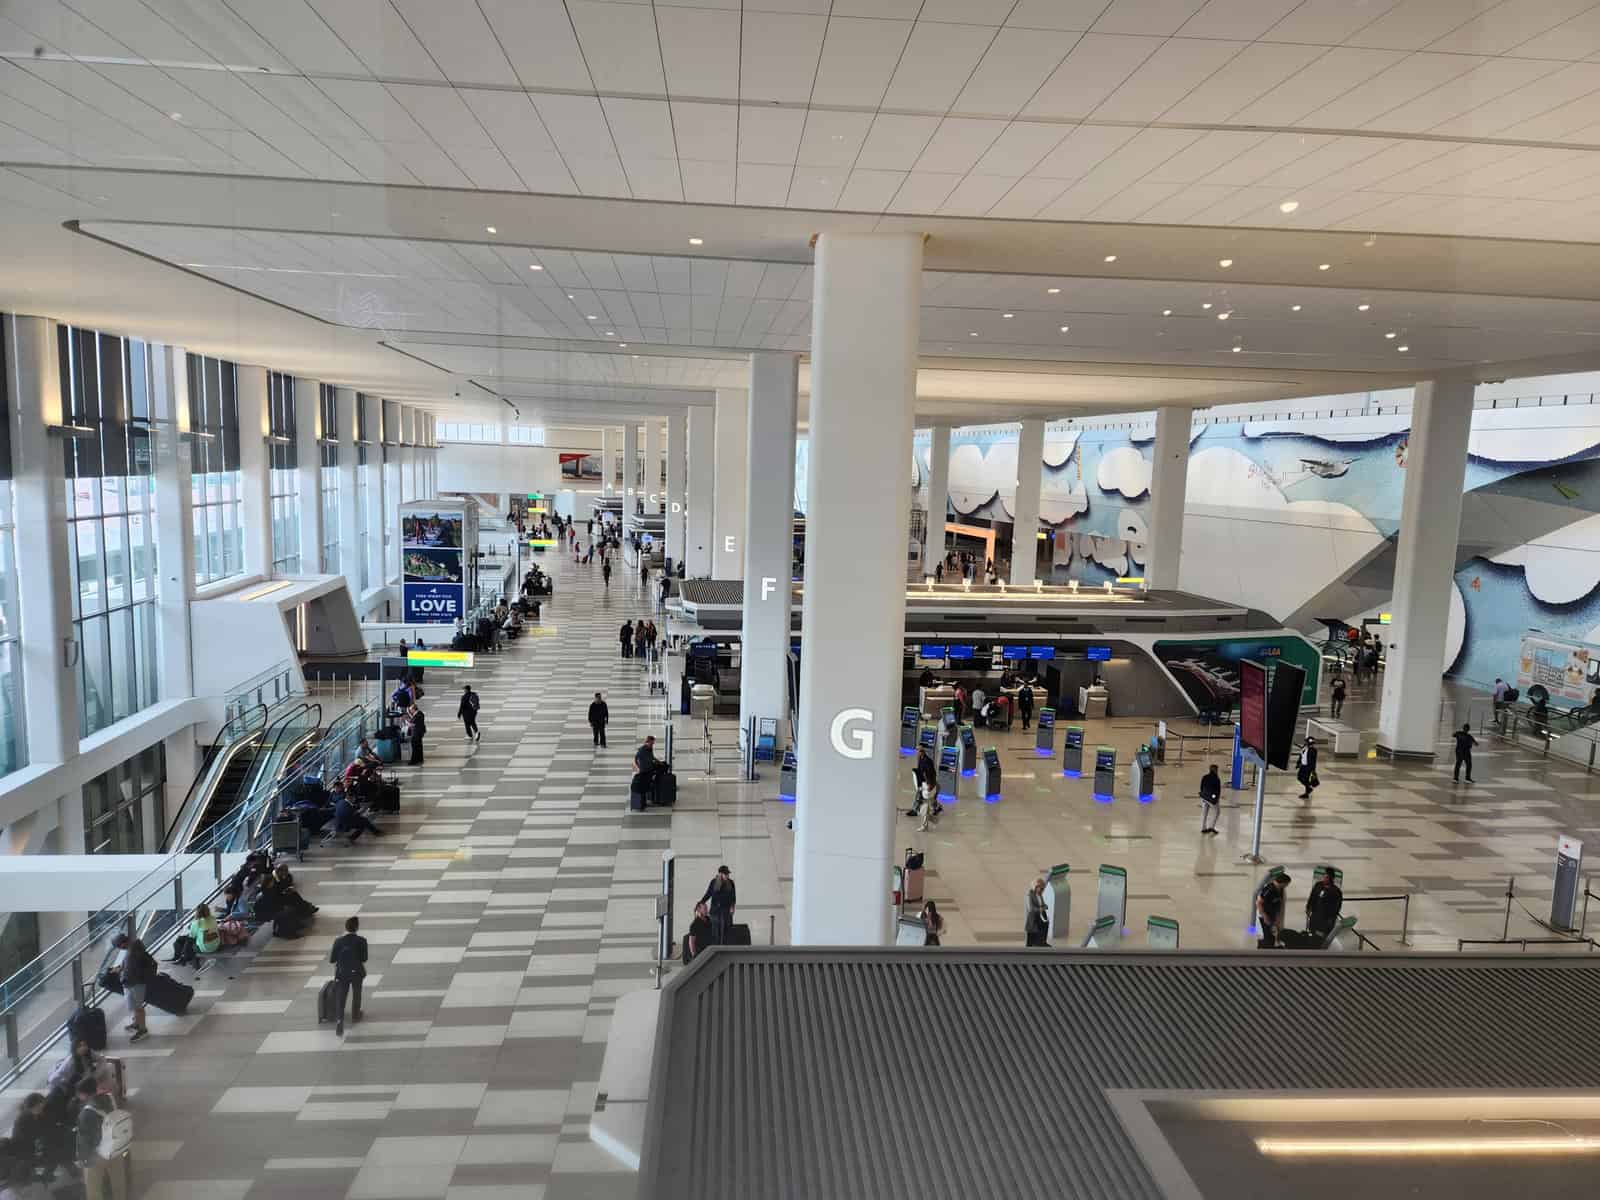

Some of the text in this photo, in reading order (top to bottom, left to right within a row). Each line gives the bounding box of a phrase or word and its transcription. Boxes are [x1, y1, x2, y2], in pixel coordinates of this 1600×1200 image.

[628, 488, 634, 496] B
[650, 494, 657, 503] C
[671, 502, 680, 512] D
[725, 536, 736, 552] E
[761, 577, 777, 601] F
[411, 599, 457, 612] LOVE
[830, 708, 874, 760] G
